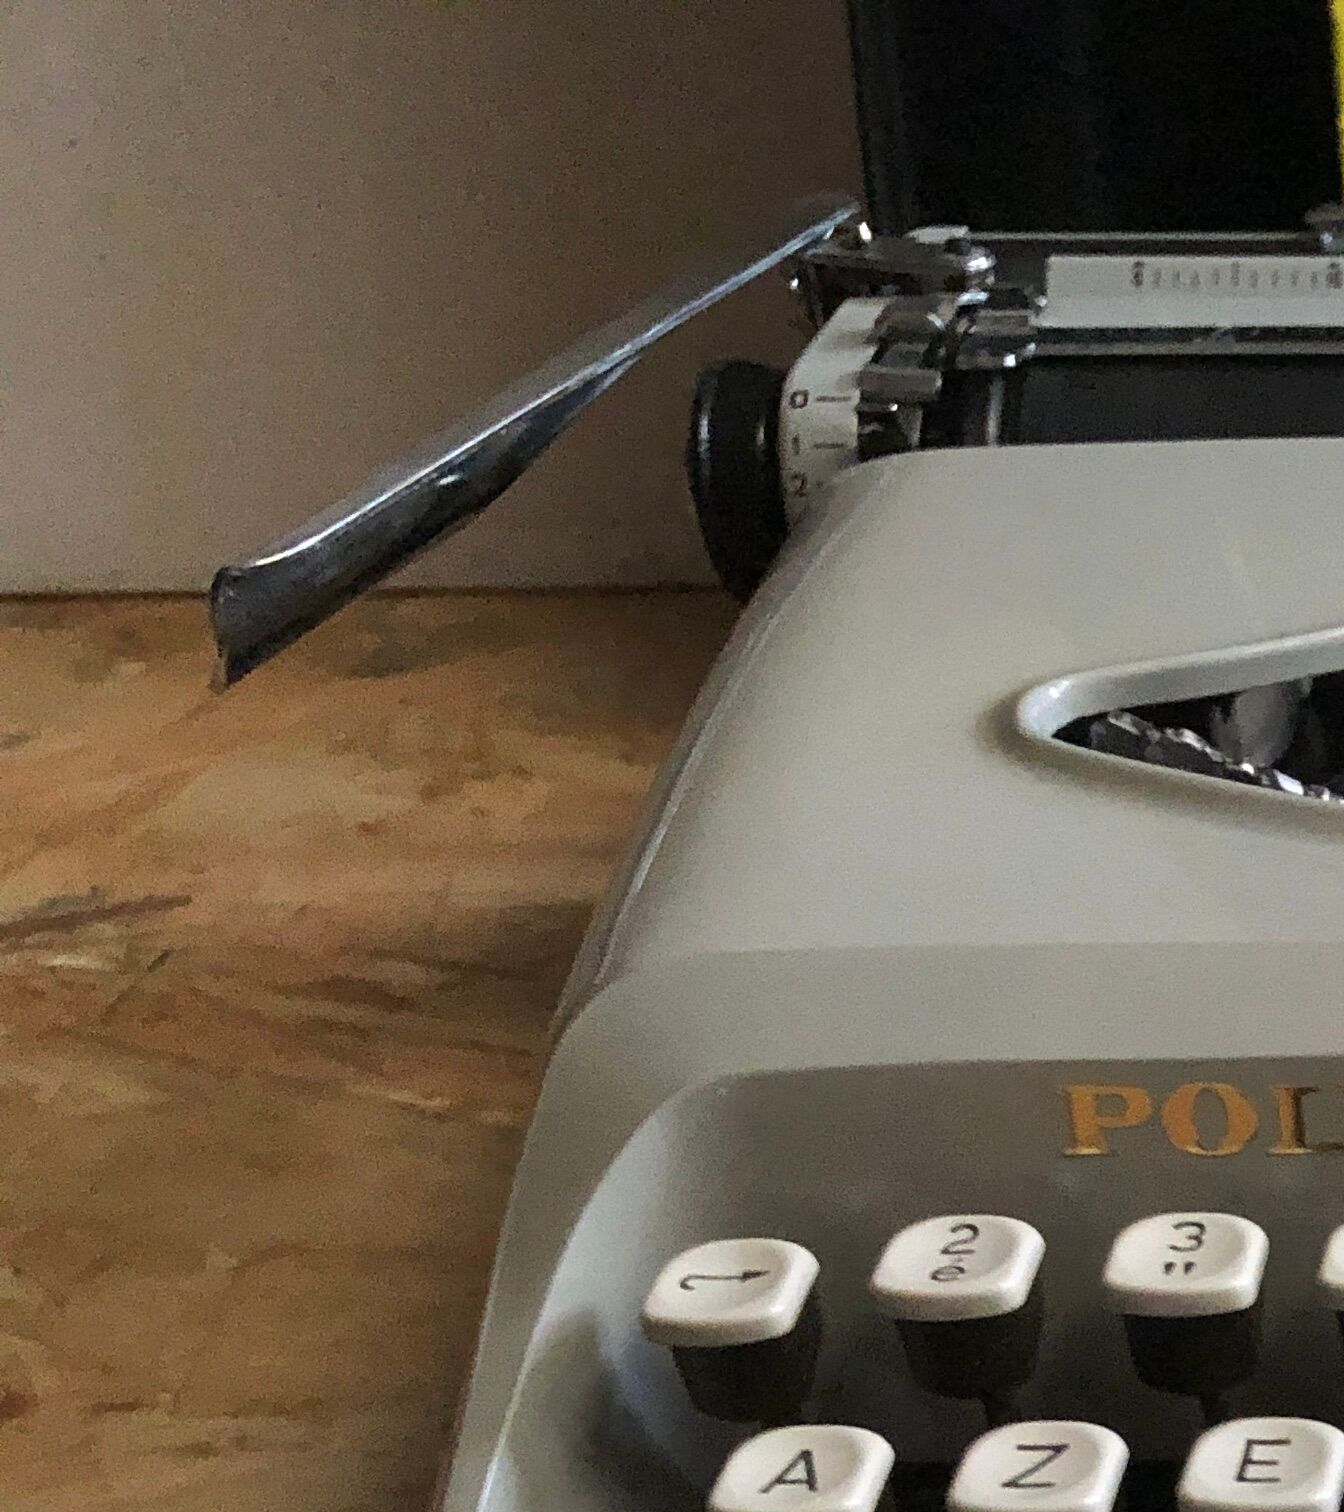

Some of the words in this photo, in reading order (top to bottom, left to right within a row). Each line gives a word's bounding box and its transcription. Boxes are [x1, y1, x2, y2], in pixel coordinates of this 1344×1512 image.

[939, 1222, 980, 1256] 2
[1168, 1220, 1207, 1253] 3
[759, 1448, 819, 1494] A
[1000, 1443, 1070, 1490] Z
[1234, 1438, 1292, 1484] E
